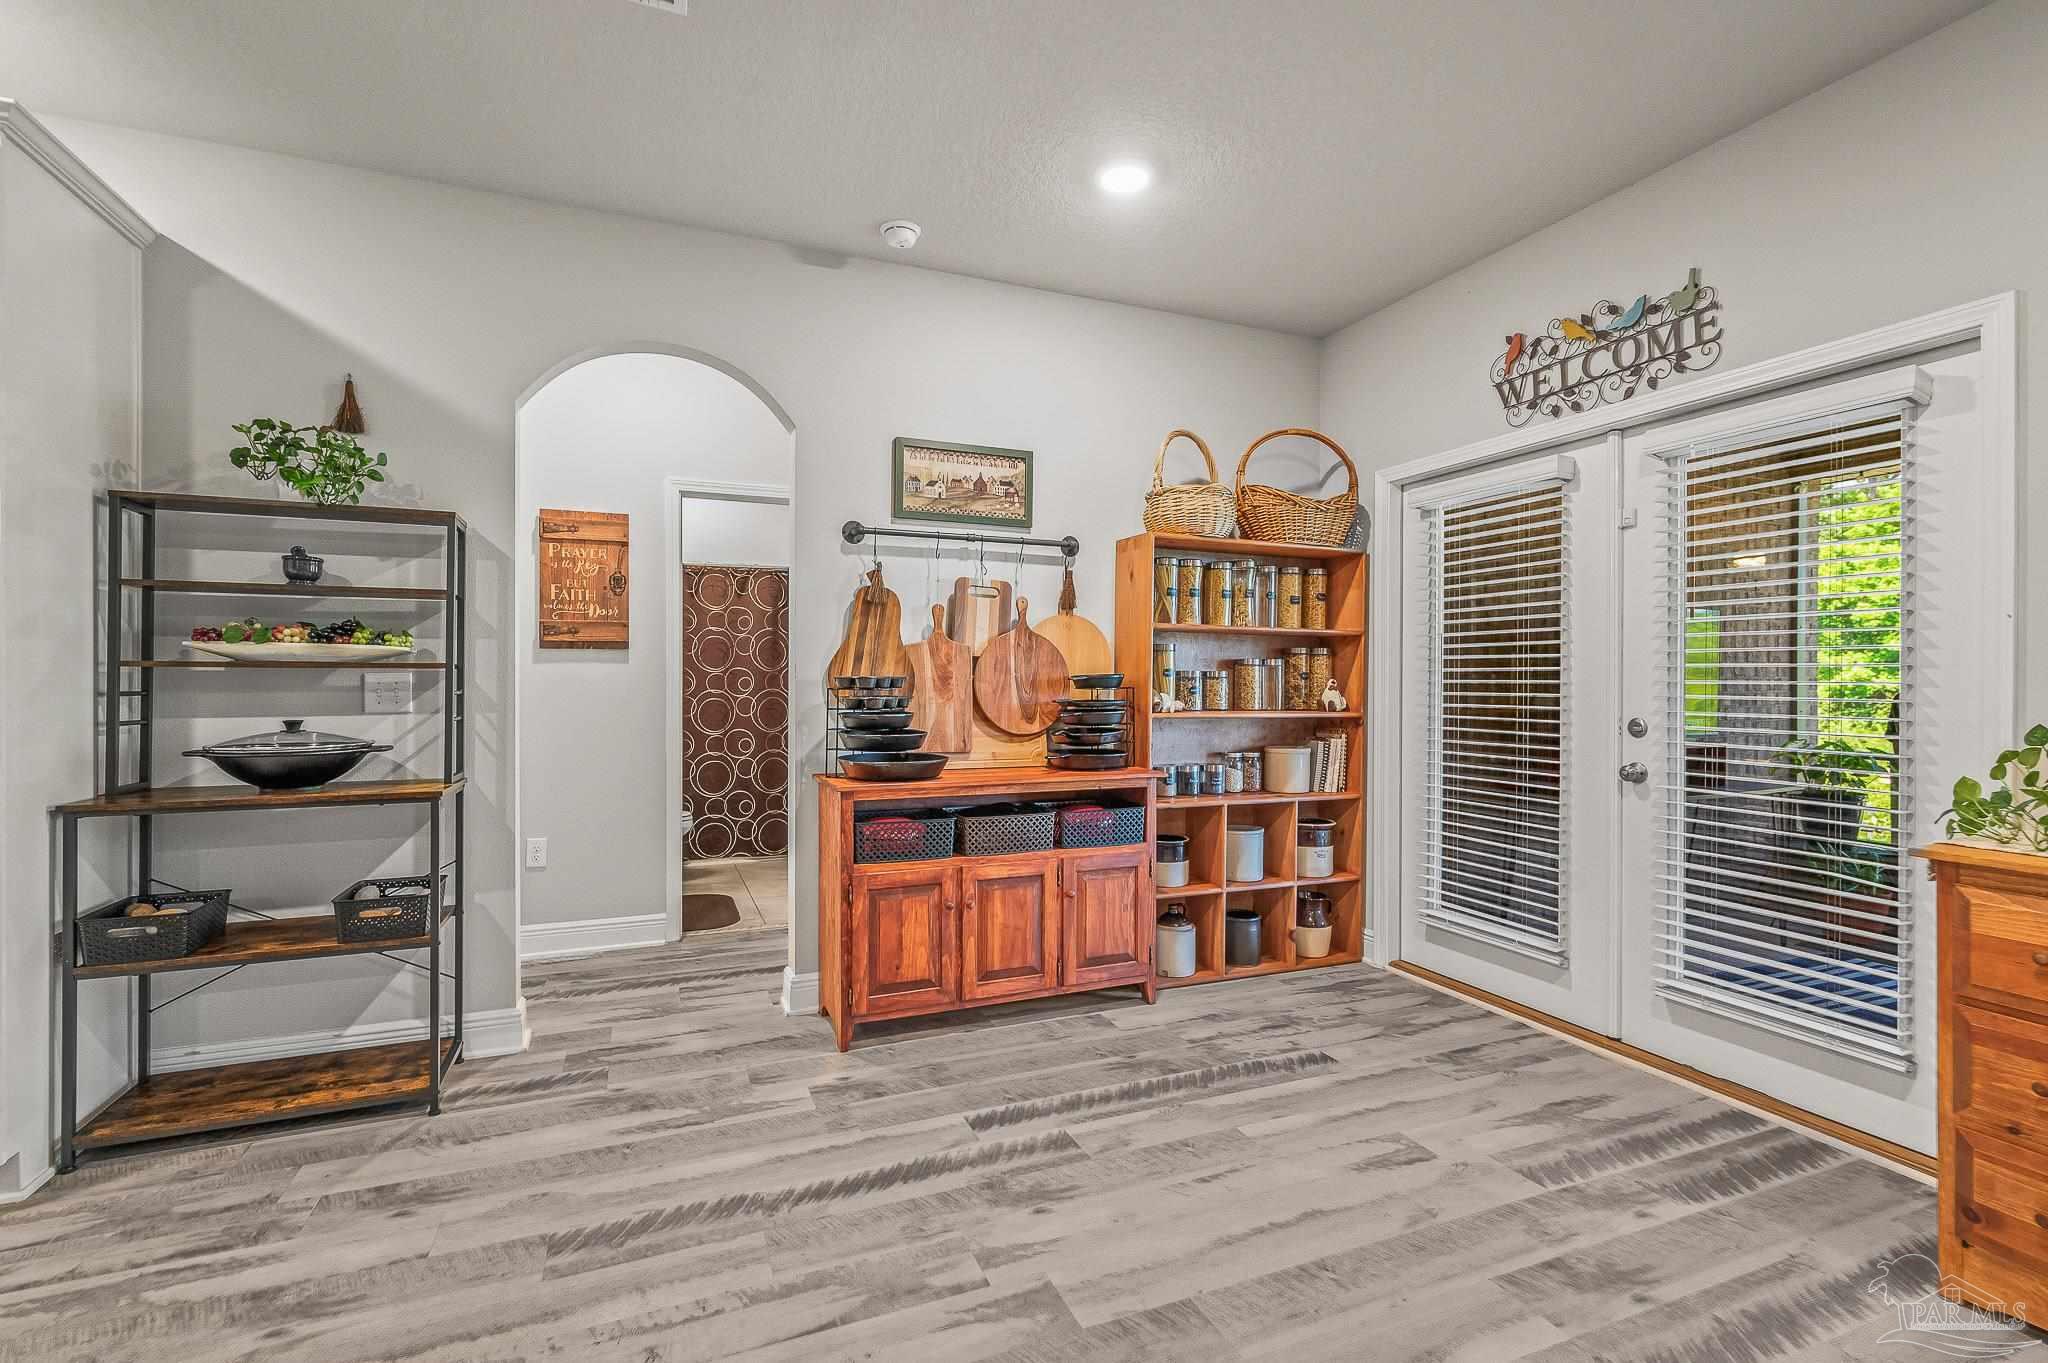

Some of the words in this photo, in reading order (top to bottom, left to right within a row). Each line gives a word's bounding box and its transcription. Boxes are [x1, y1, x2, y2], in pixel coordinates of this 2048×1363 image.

[1495, 309, 1723, 408] WELCOME
[549, 543, 607, 559] PRAYER
[574, 560, 608, 577] Key
[551, 584, 596, 601] FAITH
[588, 603, 618, 618] Door
